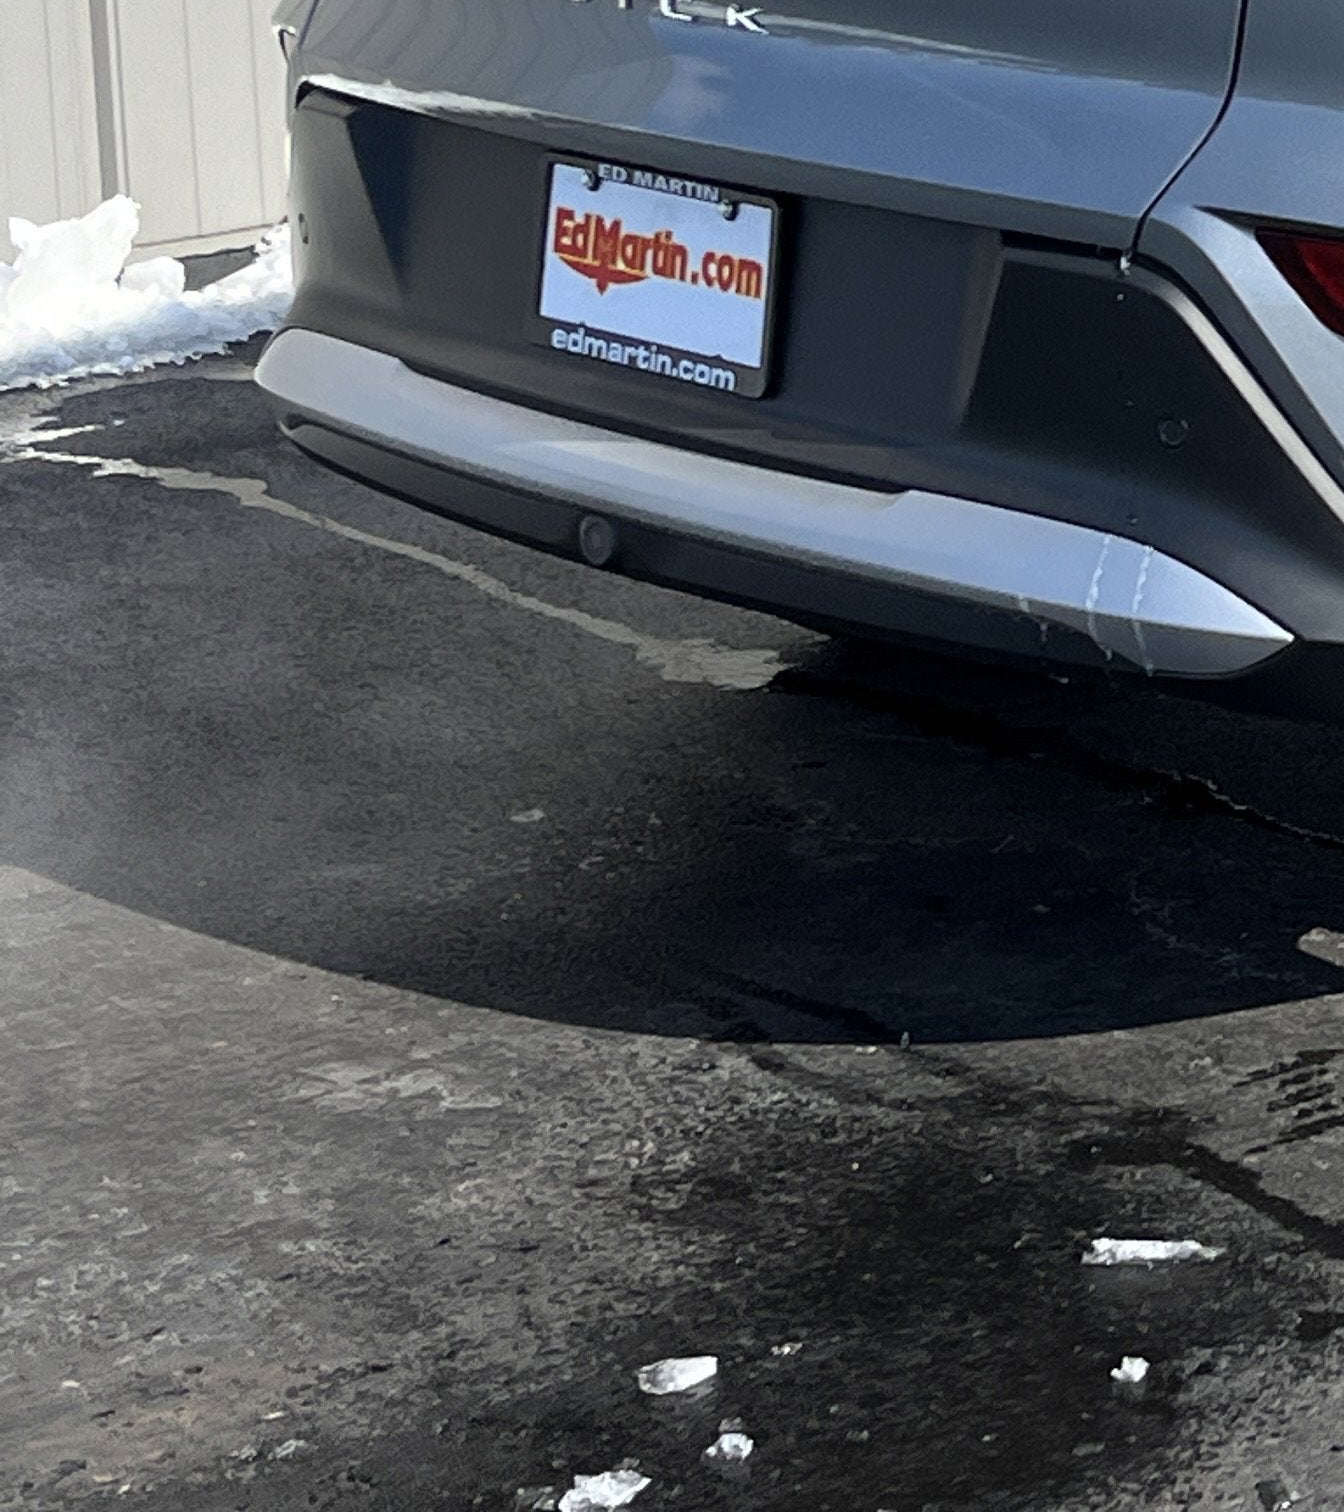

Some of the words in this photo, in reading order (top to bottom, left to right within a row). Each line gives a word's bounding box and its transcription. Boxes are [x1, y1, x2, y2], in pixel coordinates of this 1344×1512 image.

[598, 163, 627, 183] ED
[633, 168, 721, 203] MARTIN
[554, 206, 763, 299] EdMartin.com
[551, 327, 736, 392] edmartin.com
